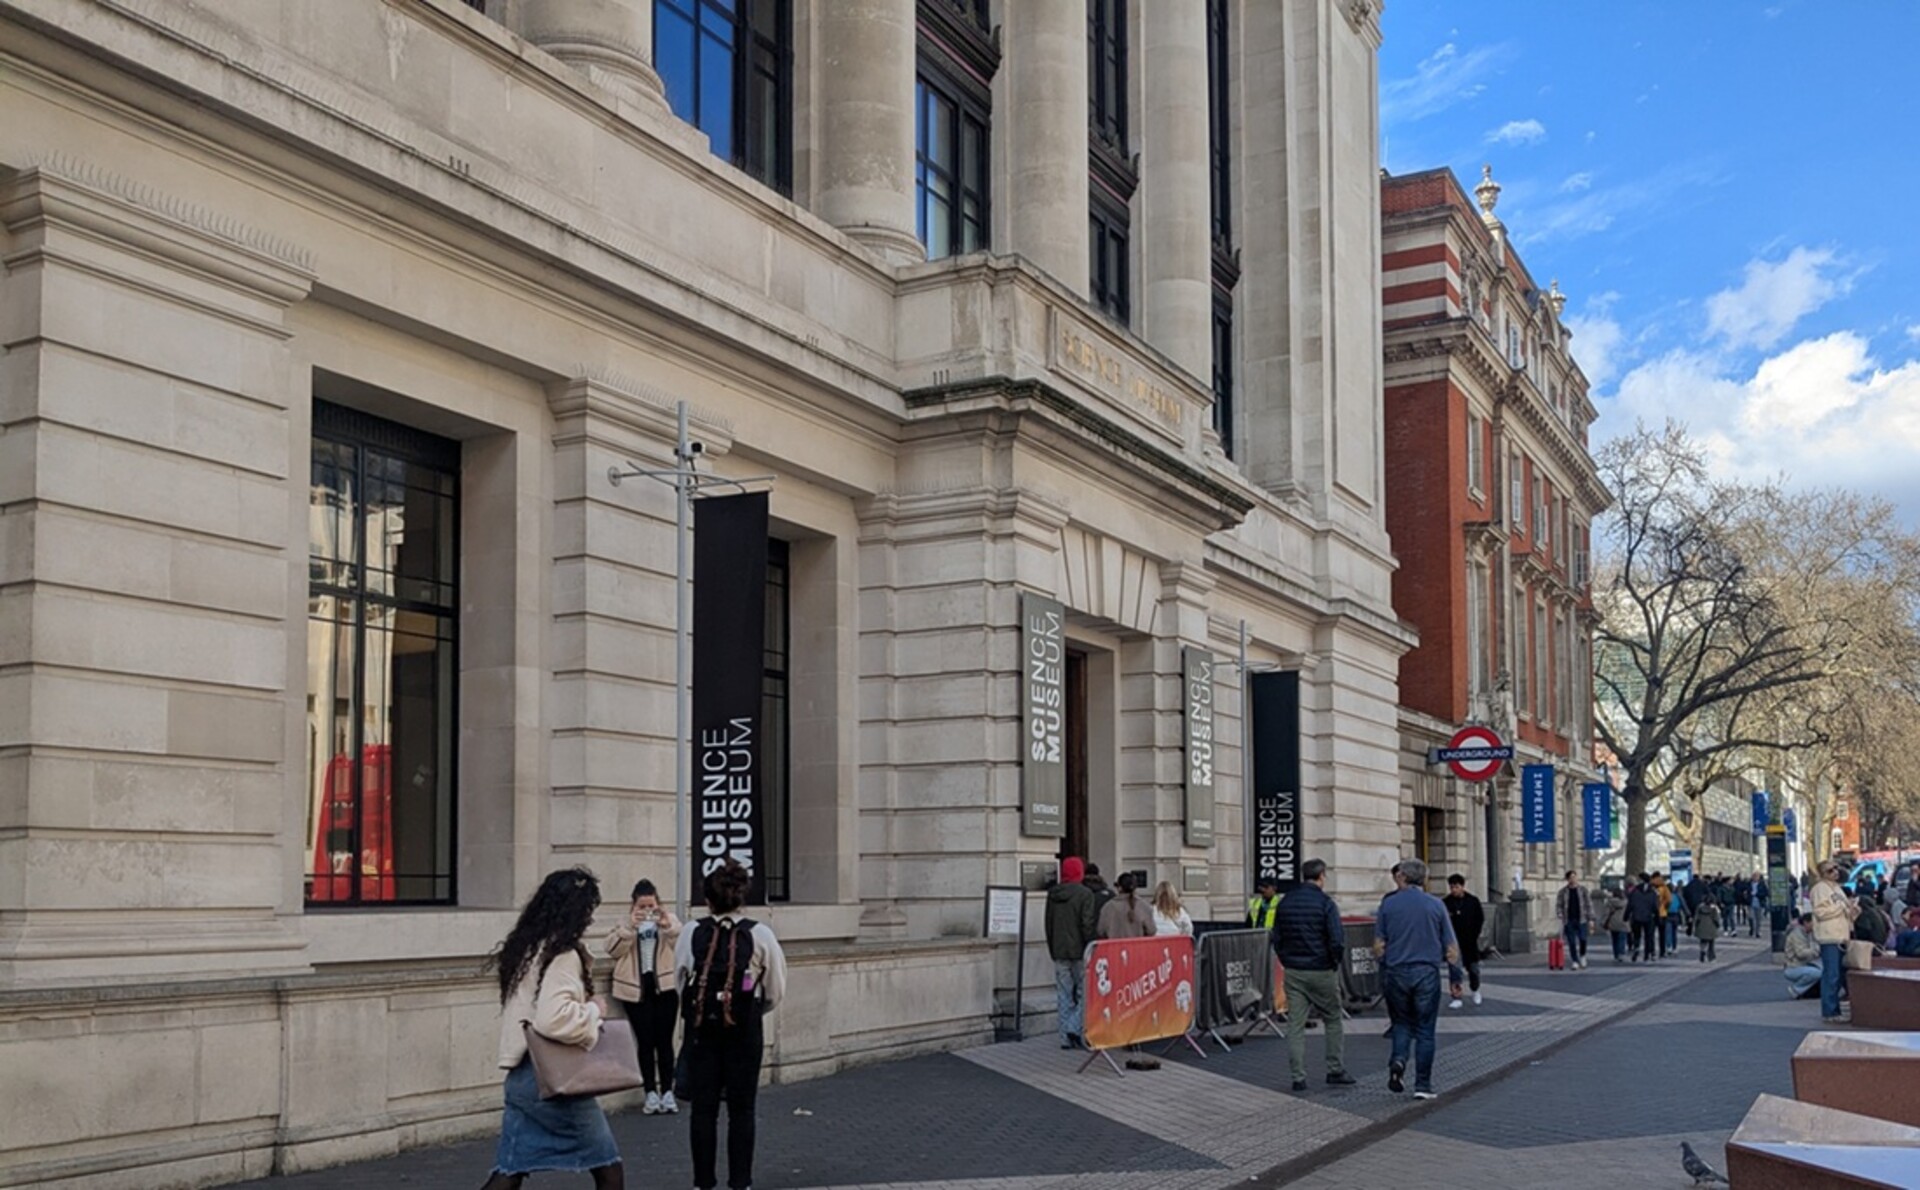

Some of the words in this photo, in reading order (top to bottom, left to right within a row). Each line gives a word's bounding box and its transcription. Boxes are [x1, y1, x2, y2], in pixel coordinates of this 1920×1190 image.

[1031, 615, 1046, 762] SCIENCE
[1046, 611, 1060, 763] MUSEUM
[1190, 665, 1201, 786] SCIENCE
[1201, 661, 1212, 786] MUSEUM
[1441, 750, 1509, 759] UNDERGROUND
[702, 728, 727, 877] SCIENCE
[1259, 798, 1276, 879] SCIENCE
[1277, 792, 1294, 880] MUSEUM
[1533, 773, 1544, 834] IMPERIAL
[1592, 790, 1602, 842] IMPERIAL
[1117, 969, 1157, 1006] POWER
[1157, 958, 1173, 984] UP
